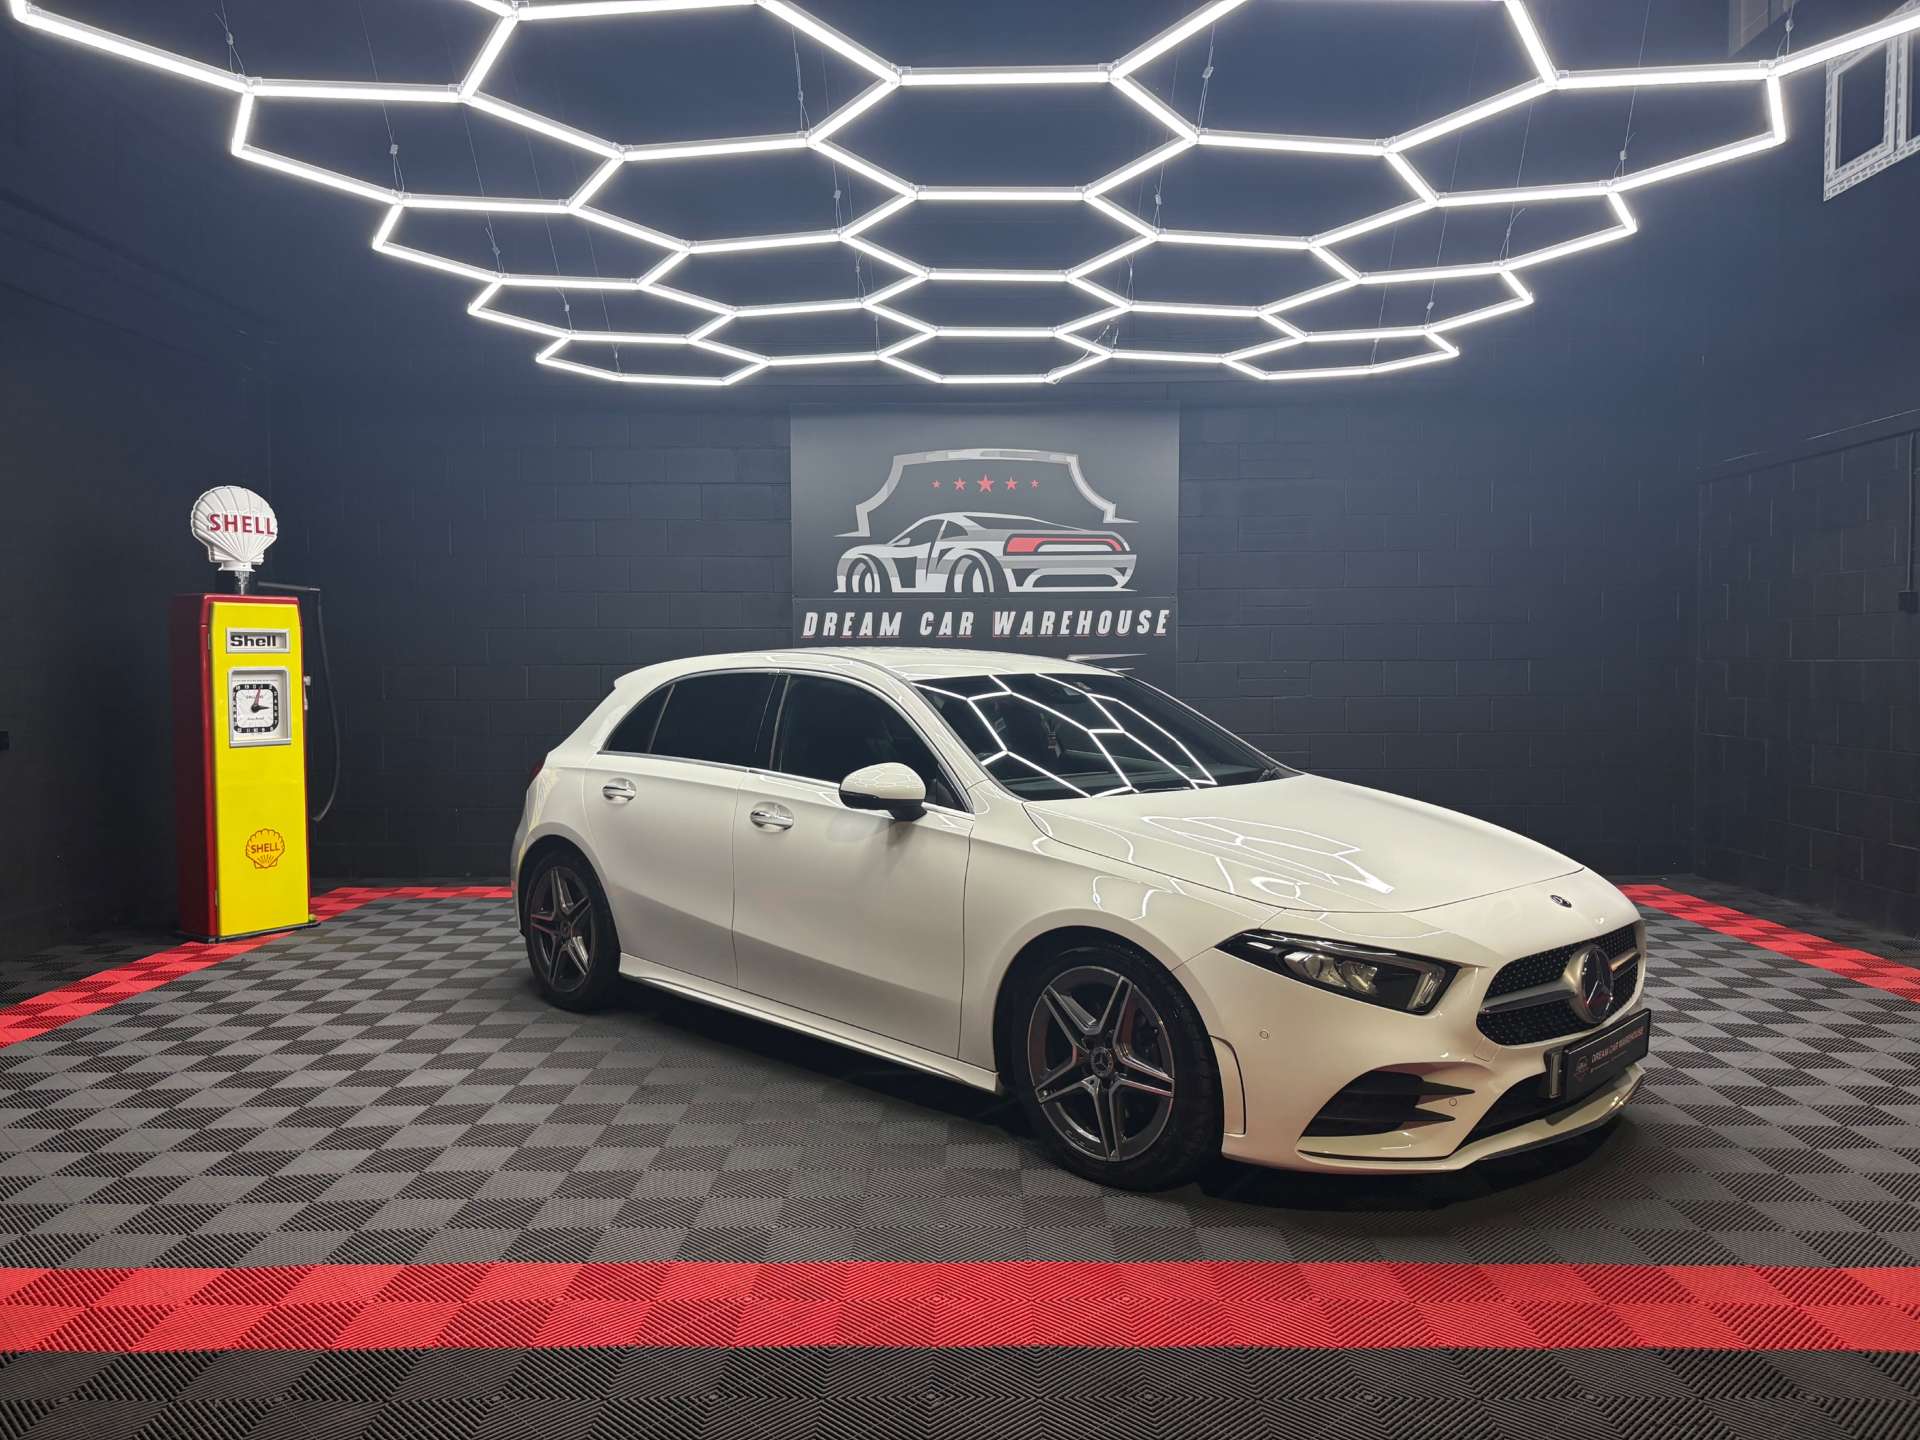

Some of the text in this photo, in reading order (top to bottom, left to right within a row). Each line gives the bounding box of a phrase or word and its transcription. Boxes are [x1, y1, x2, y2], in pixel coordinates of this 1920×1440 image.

[209, 513, 275, 535] SHELL
[802, 609, 1170, 638] DREAM CAR WAREHOUSE
[230, 635, 276, 647] Shell
[250, 842, 280, 854] SHELL
